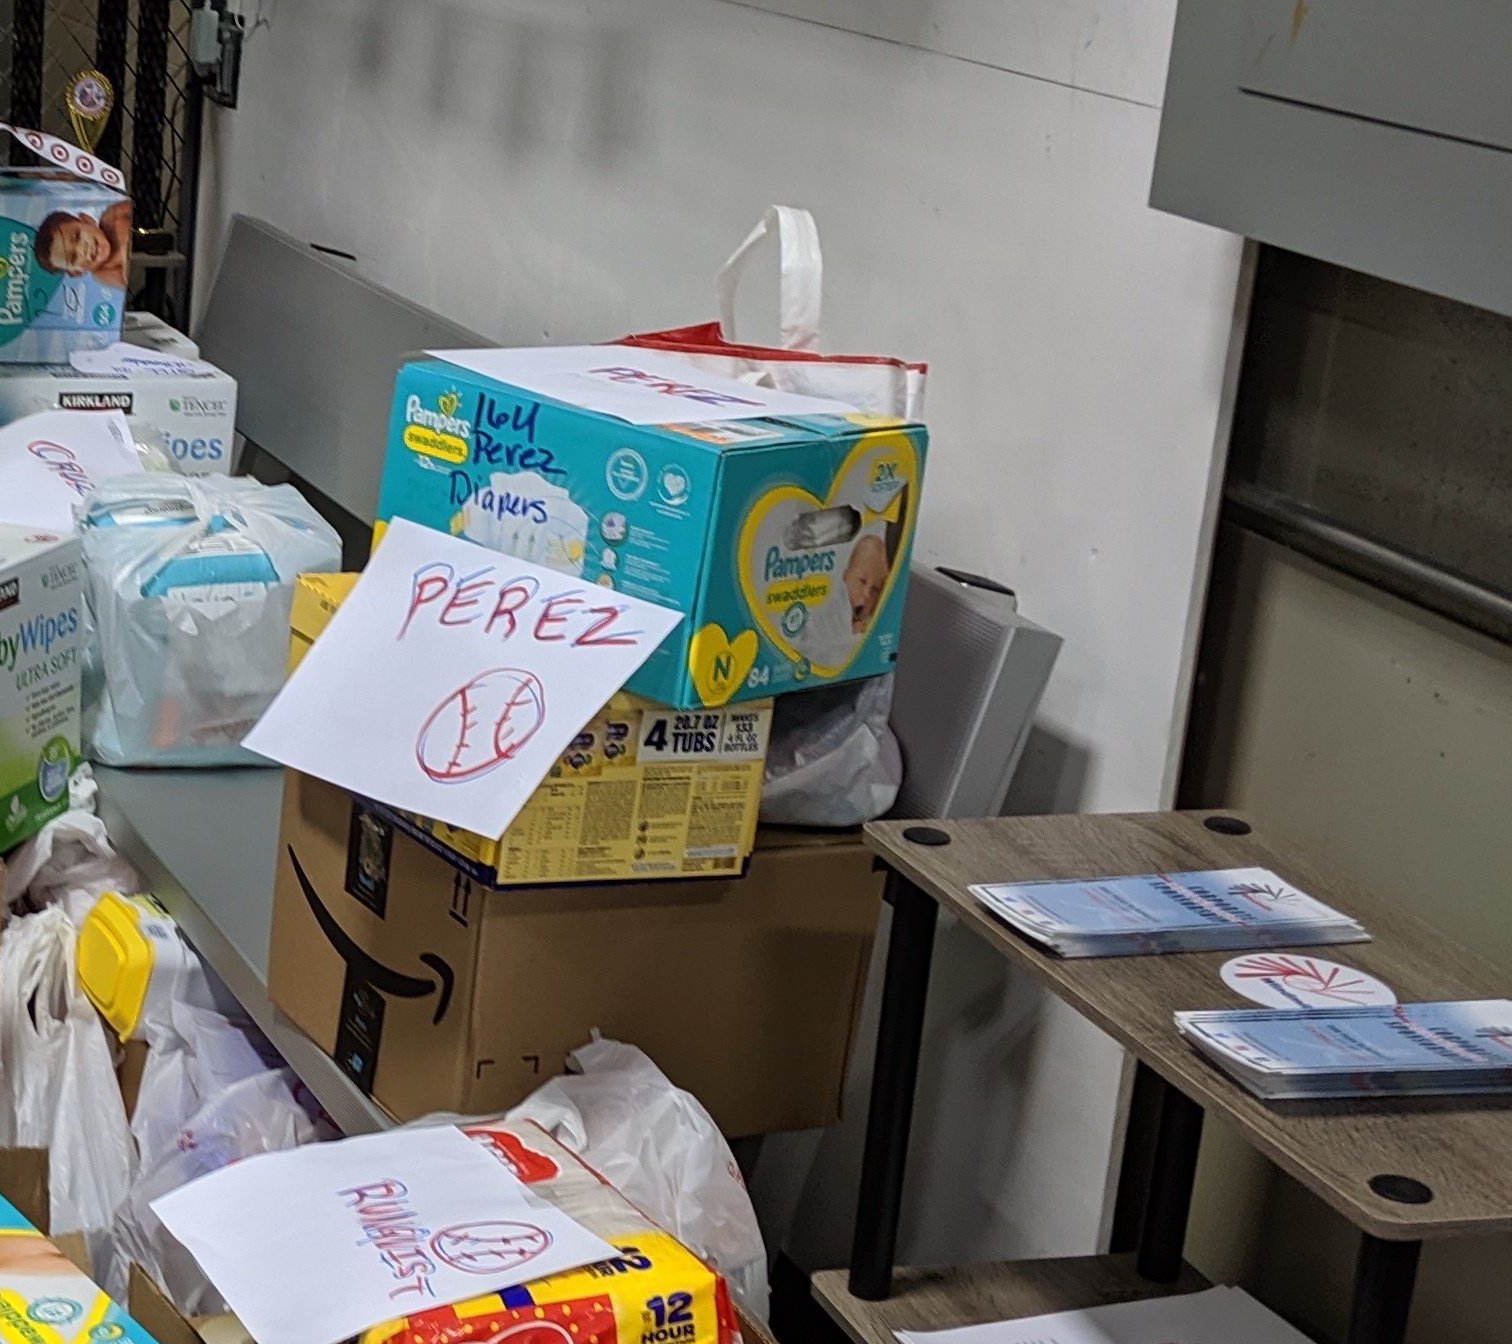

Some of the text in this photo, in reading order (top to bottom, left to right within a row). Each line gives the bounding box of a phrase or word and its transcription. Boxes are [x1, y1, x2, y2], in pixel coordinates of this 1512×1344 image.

[61, 394, 132, 408] KIRKLAND
[405, 394, 471, 439] Pampers
[473, 430, 568, 475] Perez
[875, 462, 899, 482] 2X
[449, 470, 549, 524] Diapers
[764, 545, 835, 582] Pampers
[398, 562, 644, 647] PEREZ
[766, 583, 828, 605] swaddlers
[16, 647, 79, 691] ULTRA SOFT
[713, 655, 731, 682] N
[748, 667, 770, 689] 84
[644, 719, 668, 752] 4
[673, 732, 717, 753] TUBS
[646, 1291, 694, 1327] 12
[640, 1323, 696, 1344] HOUR
